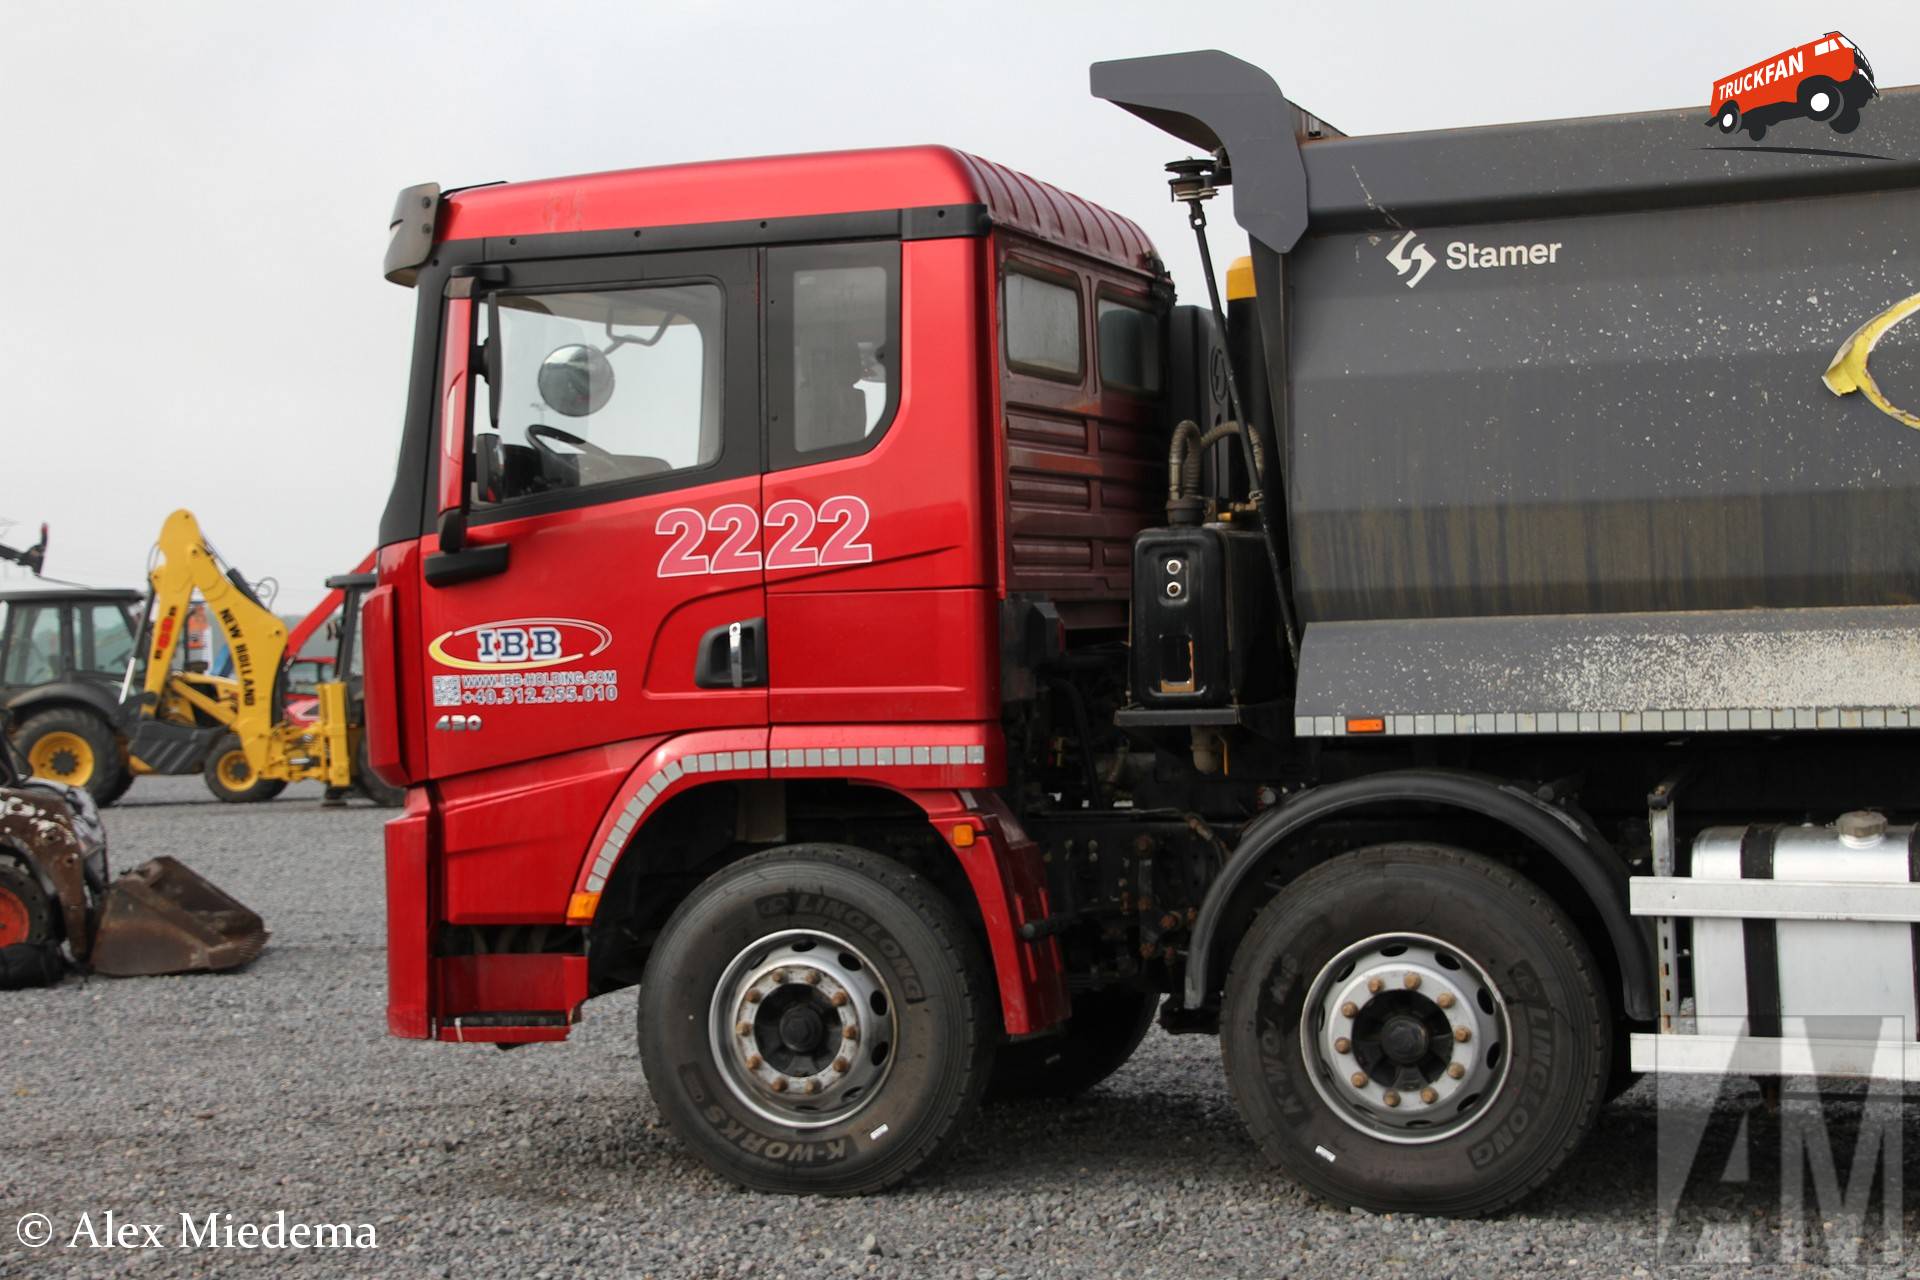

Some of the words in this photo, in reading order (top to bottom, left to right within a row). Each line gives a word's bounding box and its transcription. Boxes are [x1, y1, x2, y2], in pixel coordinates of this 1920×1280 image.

[1446, 241, 1562, 270] Stamer
[655, 496, 873, 578] 2222
[220, 608, 242, 639] NEW
[235, 643, 255, 706] HOLLAND
[479, 628, 561, 660] IBB
[797, 894, 923, 999] LINGLONG
[703, 1103, 847, 1162] K-WORKS
